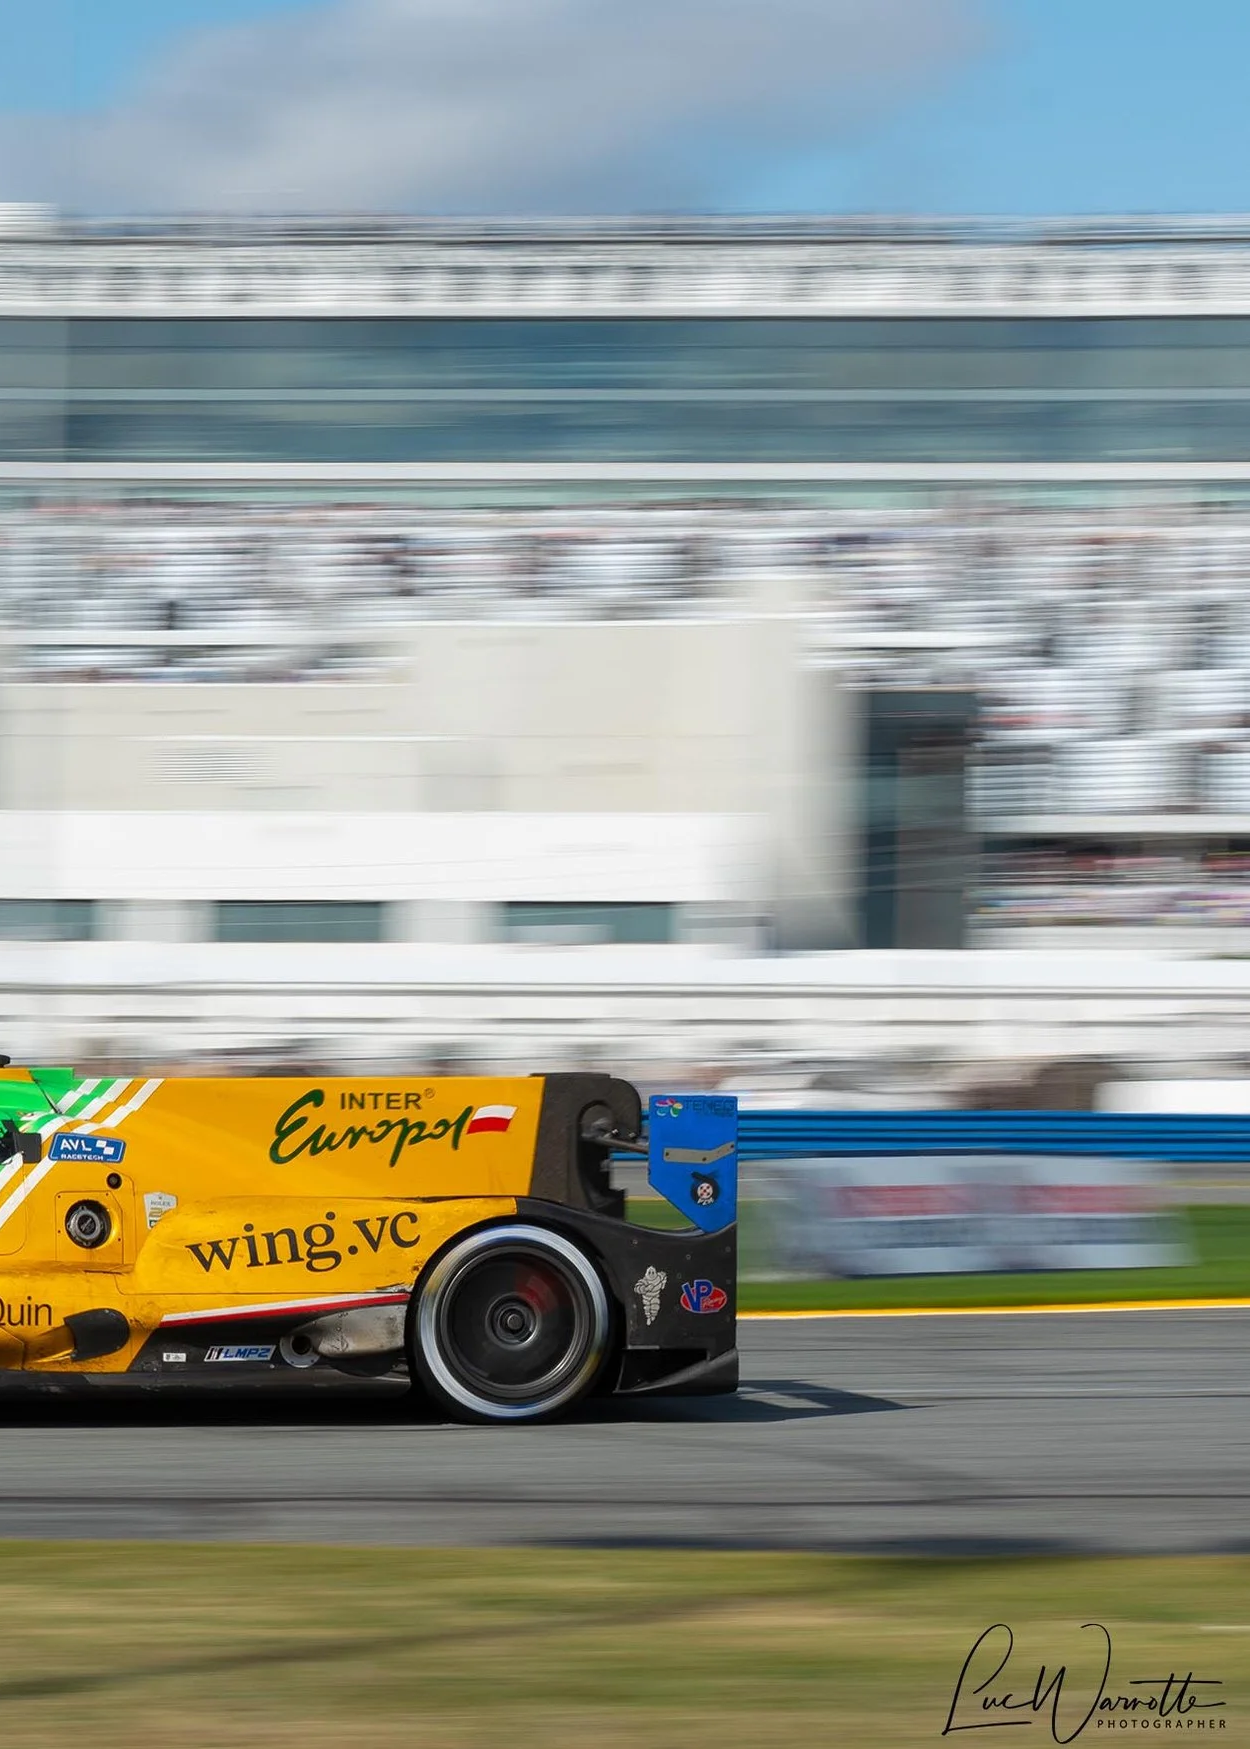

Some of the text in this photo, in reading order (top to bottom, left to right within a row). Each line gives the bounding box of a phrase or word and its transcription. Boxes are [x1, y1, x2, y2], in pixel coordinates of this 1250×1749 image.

[269, 1089, 474, 1167] Europol
[60, 1139, 92, 1151] AVL
[60, 1153, 104, 1161] RACETECH
[185, 1210, 422, 1273] wing.vc
[681, 1279, 714, 1313] VP
[222, 1347, 271, 1359] LMP2
